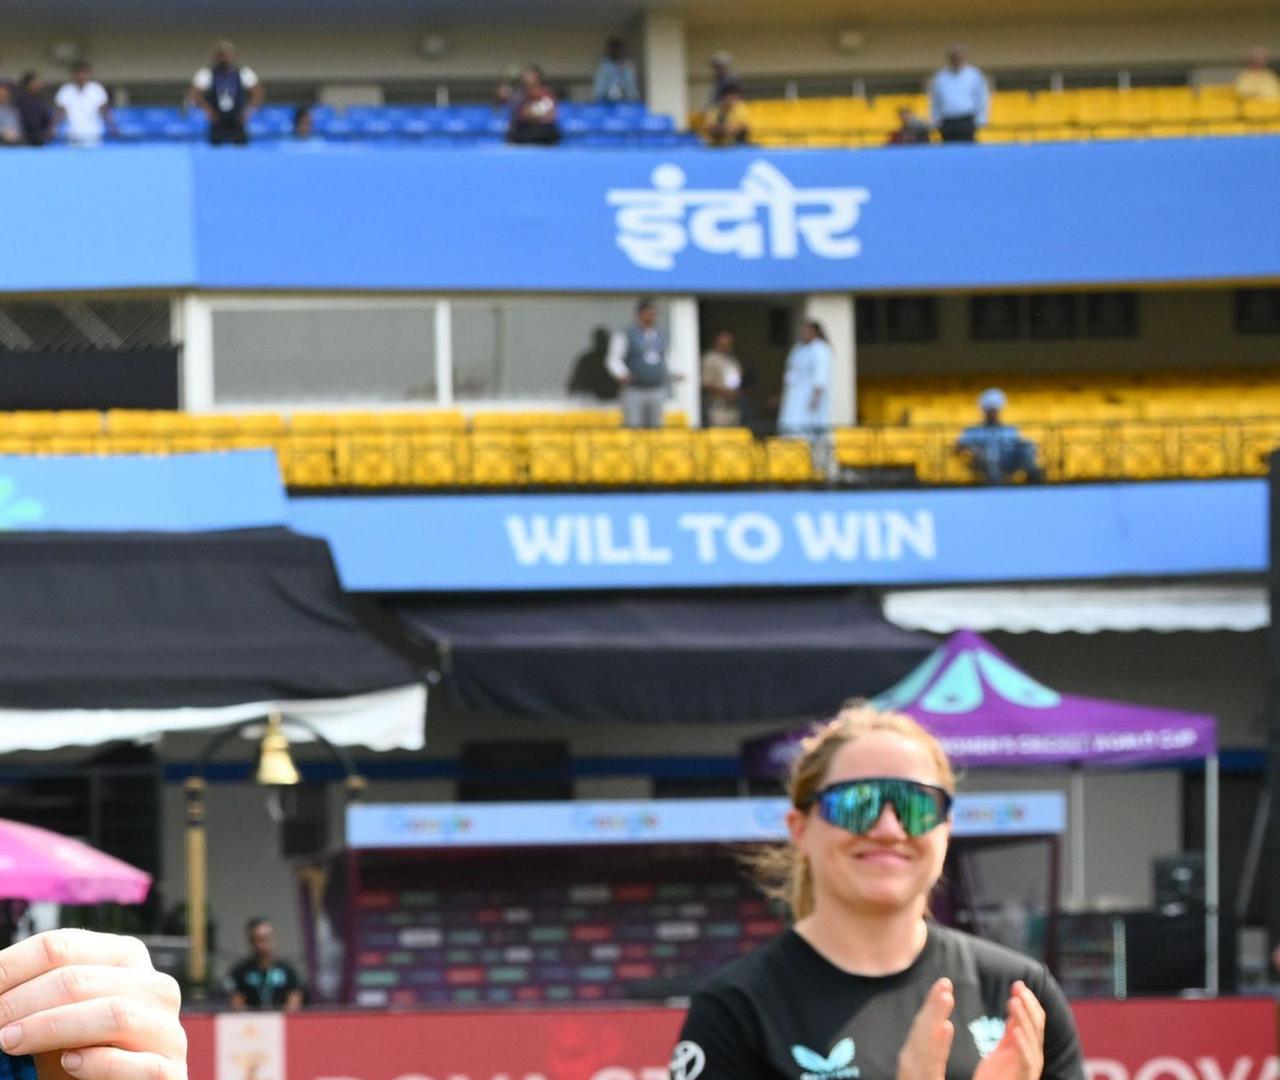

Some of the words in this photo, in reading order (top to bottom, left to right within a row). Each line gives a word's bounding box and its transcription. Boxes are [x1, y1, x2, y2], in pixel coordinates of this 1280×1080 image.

[605, 158, 871, 272] इंदौर
[504, 513, 673, 566] WILL
[677, 512, 784, 565] TO
[792, 508, 938, 563] WIN
